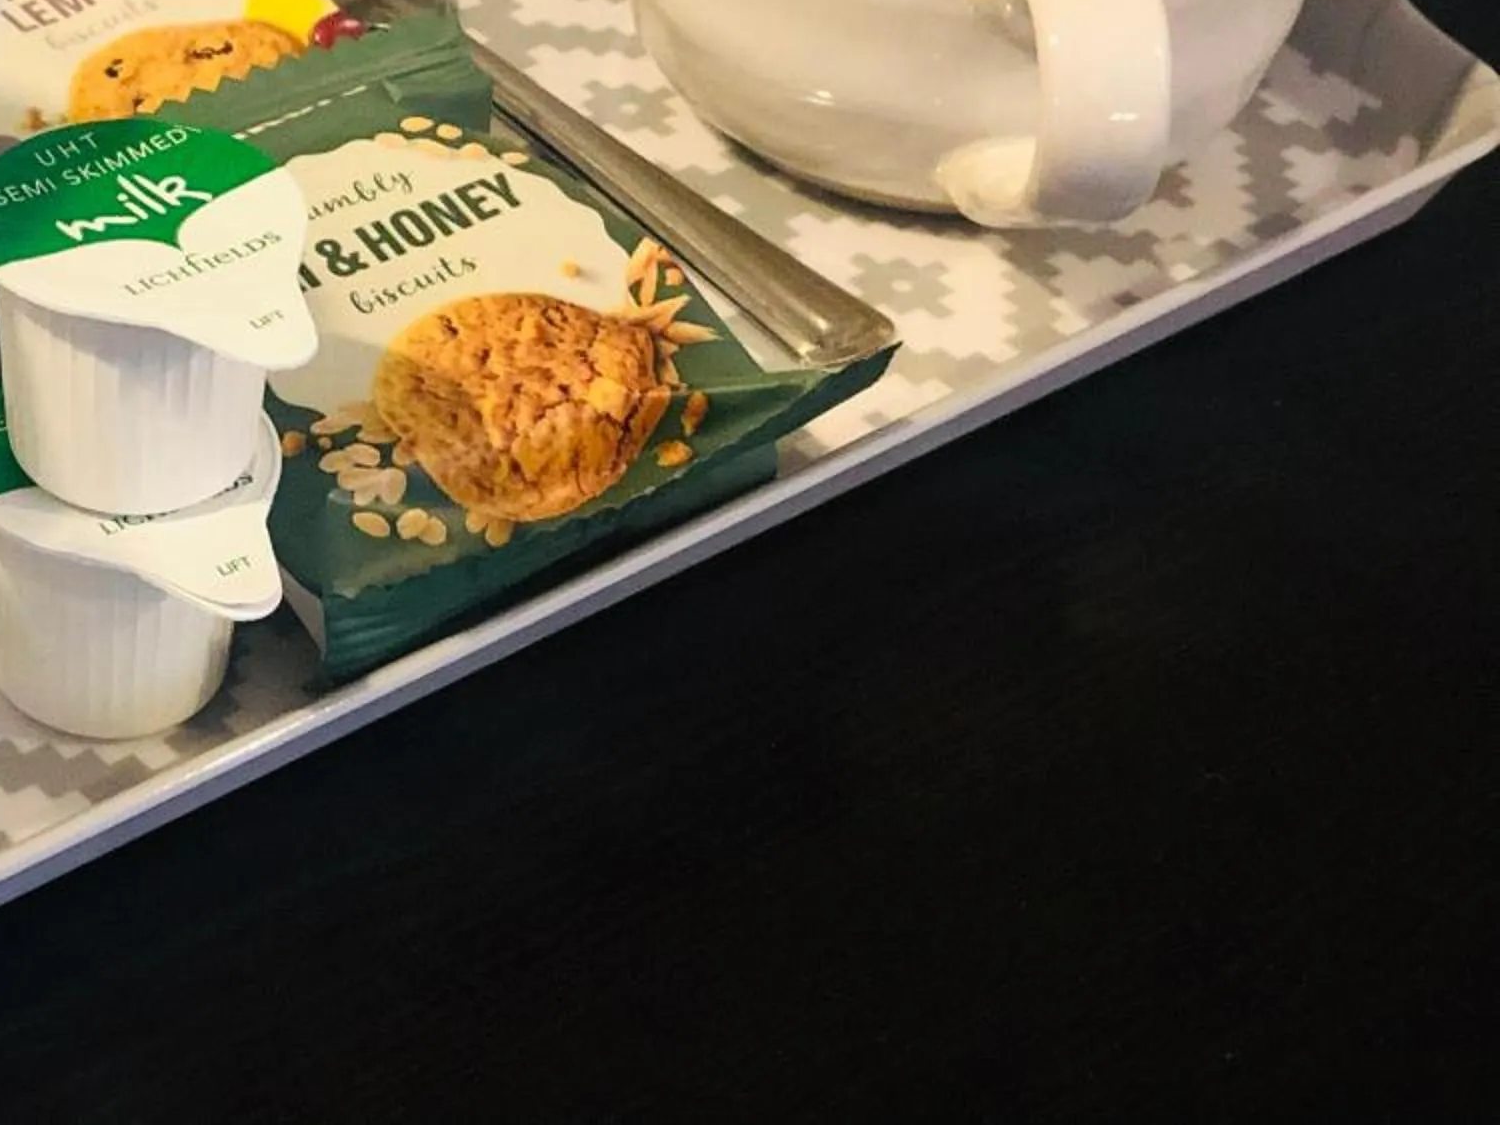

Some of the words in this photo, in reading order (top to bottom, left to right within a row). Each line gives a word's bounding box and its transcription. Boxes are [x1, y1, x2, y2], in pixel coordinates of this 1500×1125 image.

[35, 131, 98, 167] UHT
[61, 127, 188, 186] SKIMMED
[55, 174, 213, 241] milk
[307, 168, 414, 221] umbly
[354, 172, 522, 263] HONEY
[349, 255, 479, 315] biscuits
[216, 556, 252, 577] LIFT
